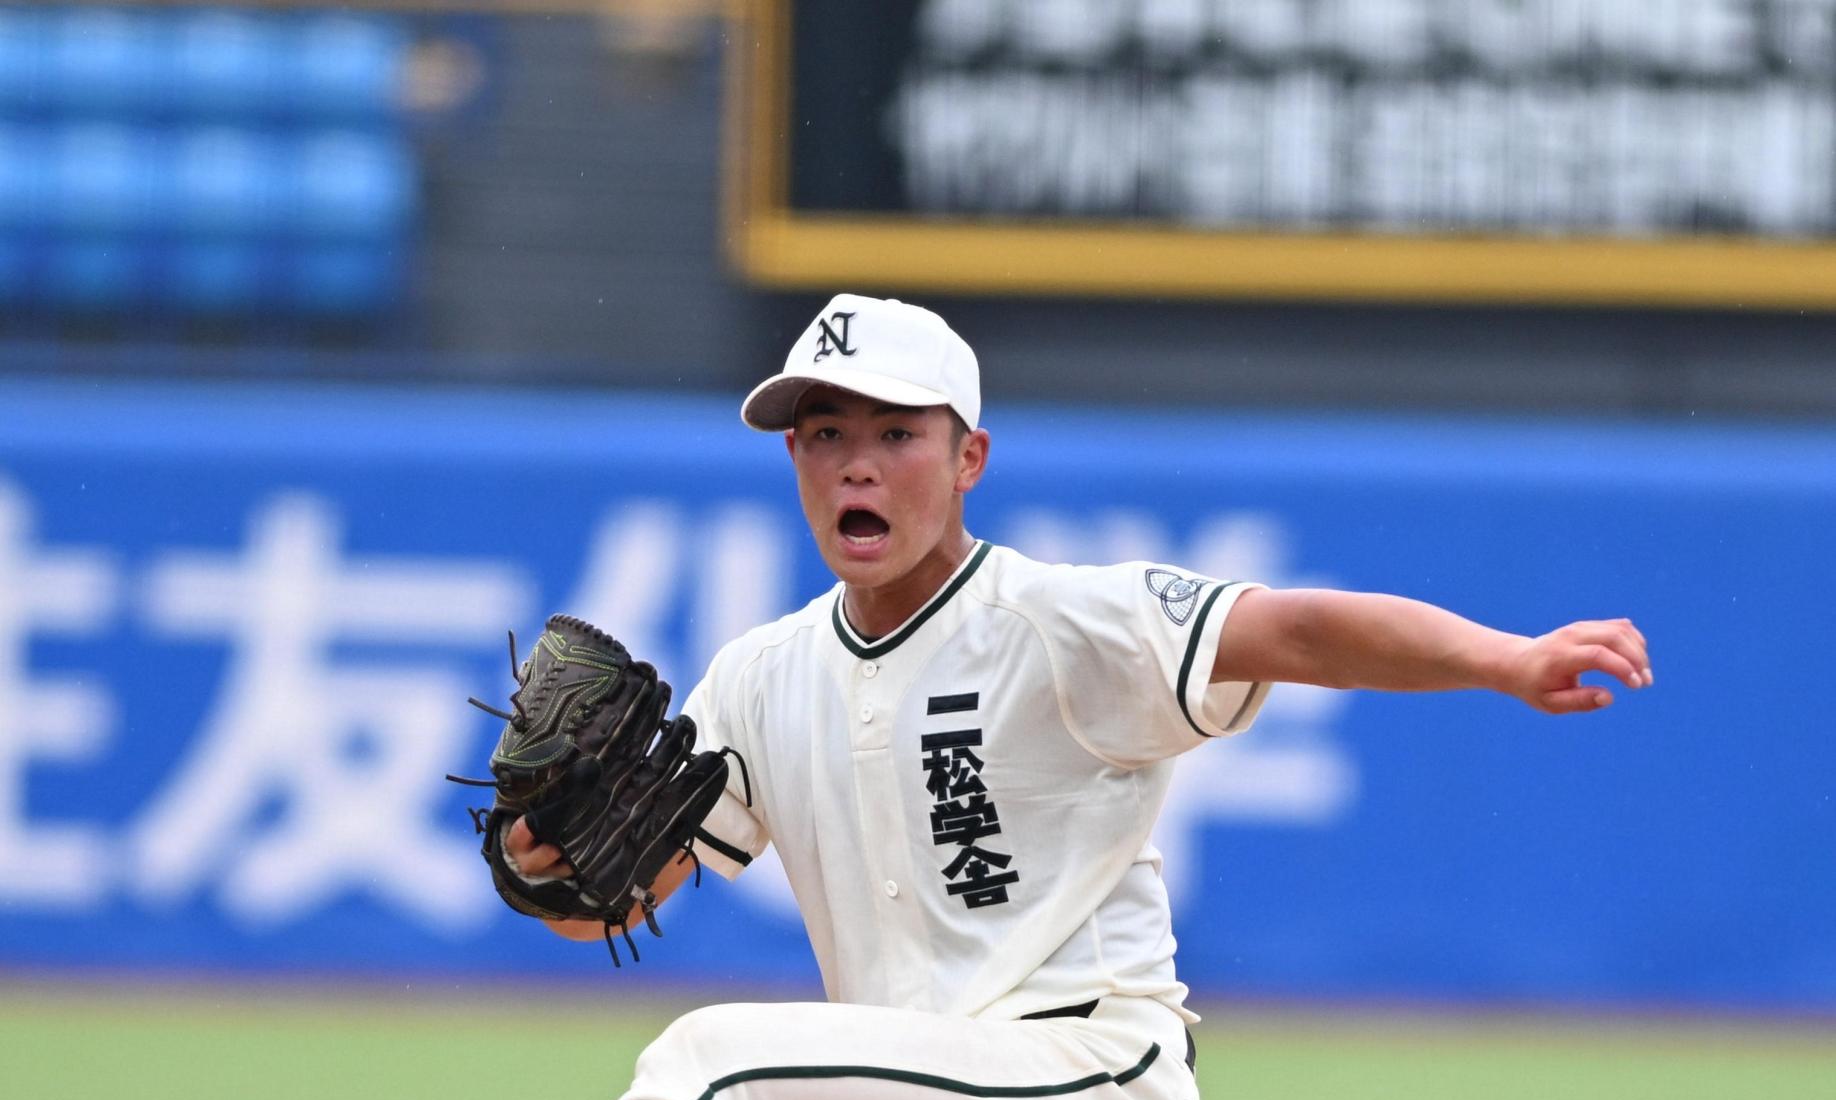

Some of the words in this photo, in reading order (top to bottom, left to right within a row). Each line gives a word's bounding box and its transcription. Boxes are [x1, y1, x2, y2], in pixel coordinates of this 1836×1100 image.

[813, 311, 857, 363] N
[921, 692, 1020, 909] 二松学舎
